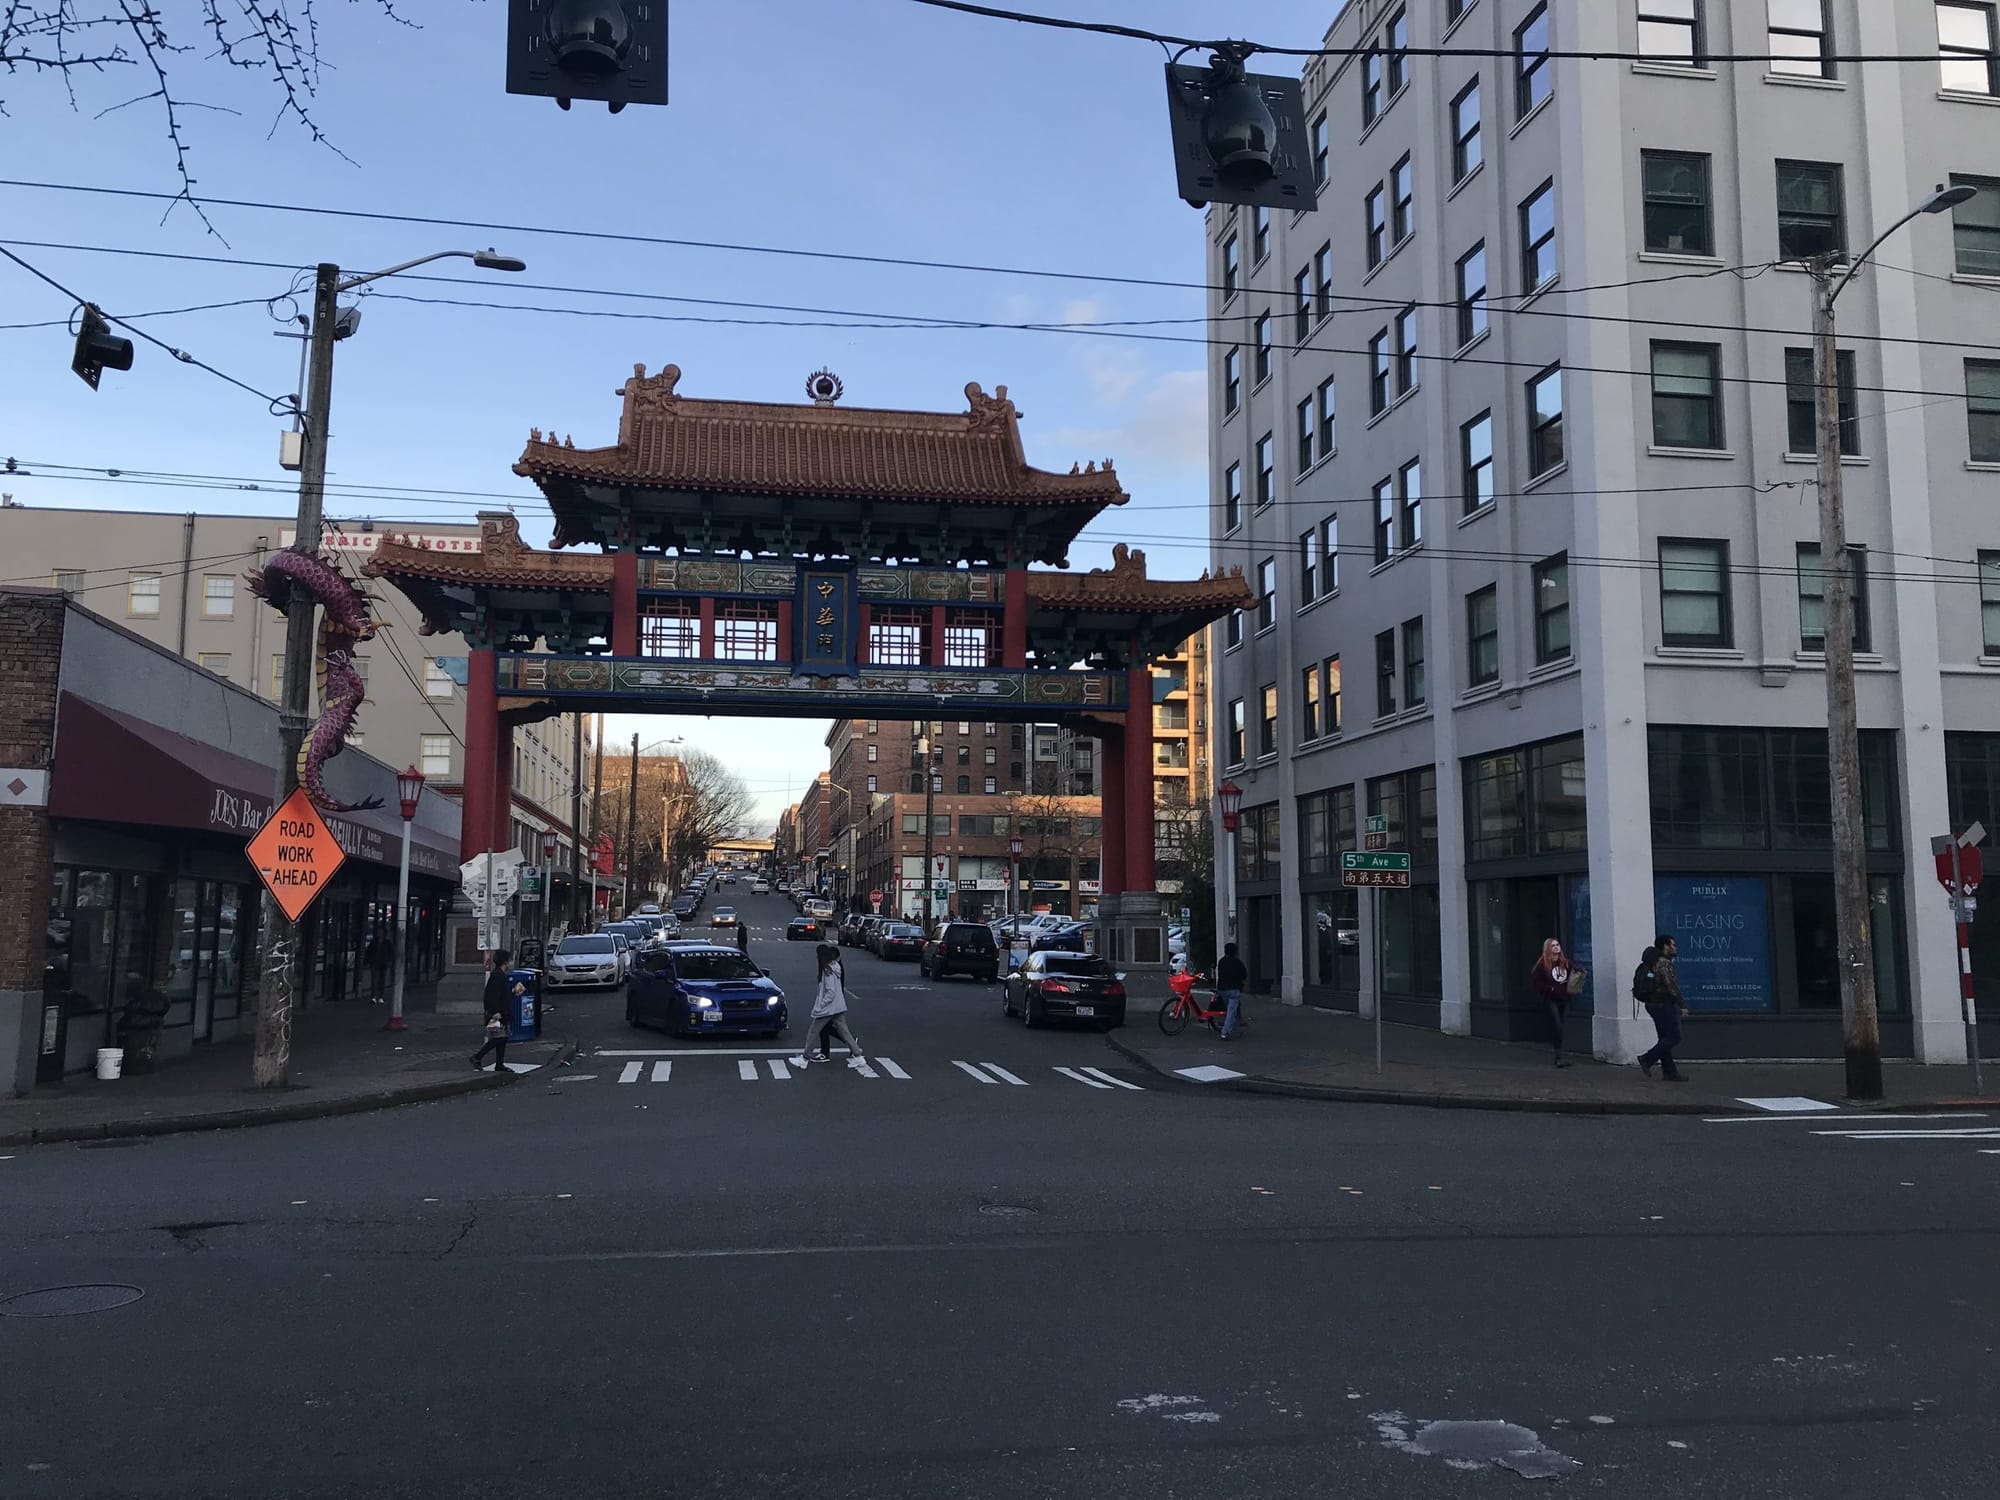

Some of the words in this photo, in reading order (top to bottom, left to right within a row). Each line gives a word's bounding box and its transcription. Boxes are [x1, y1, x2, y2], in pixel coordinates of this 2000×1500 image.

[241, 799, 262, 829] Bar
[280, 820, 315, 838] ROAD
[278, 845, 314, 863] WORK
[1346, 855, 1365, 867] 5th
[1372, 857, 1389, 867] Ave
[1401, 857, 1408, 867] S
[272, 869, 317, 886] AHEAD
[528, 880, 535, 888] 2
[1345, 872, 1407, 885] 南第五大道
[1692, 886, 1728, 896] PUBLIX
[1675, 913, 1745, 930] LEASING
[1690, 934, 1732, 950] NOW
